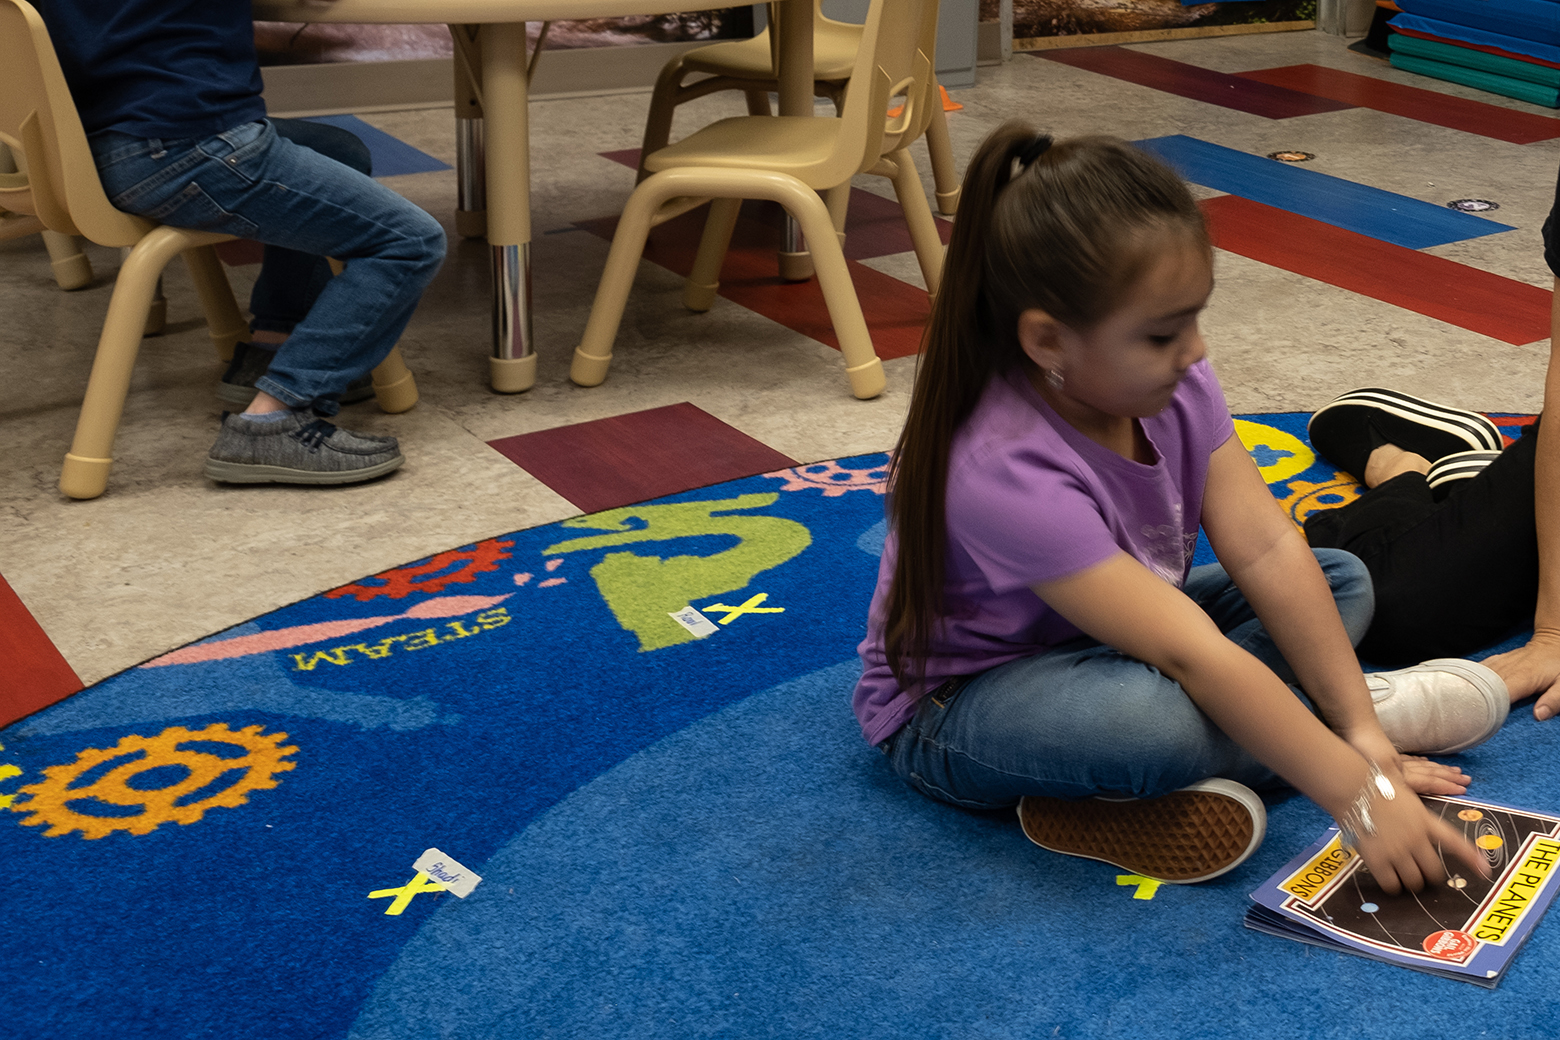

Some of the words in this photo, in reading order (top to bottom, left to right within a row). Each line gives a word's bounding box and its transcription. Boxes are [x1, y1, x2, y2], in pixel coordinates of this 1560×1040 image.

[289, 607, 511, 671] STEAM
[426, 861, 465, 883] Shadi
[1290, 848, 1352, 898] GIBBONS
[1475, 872, 1542, 942] PLANETS
